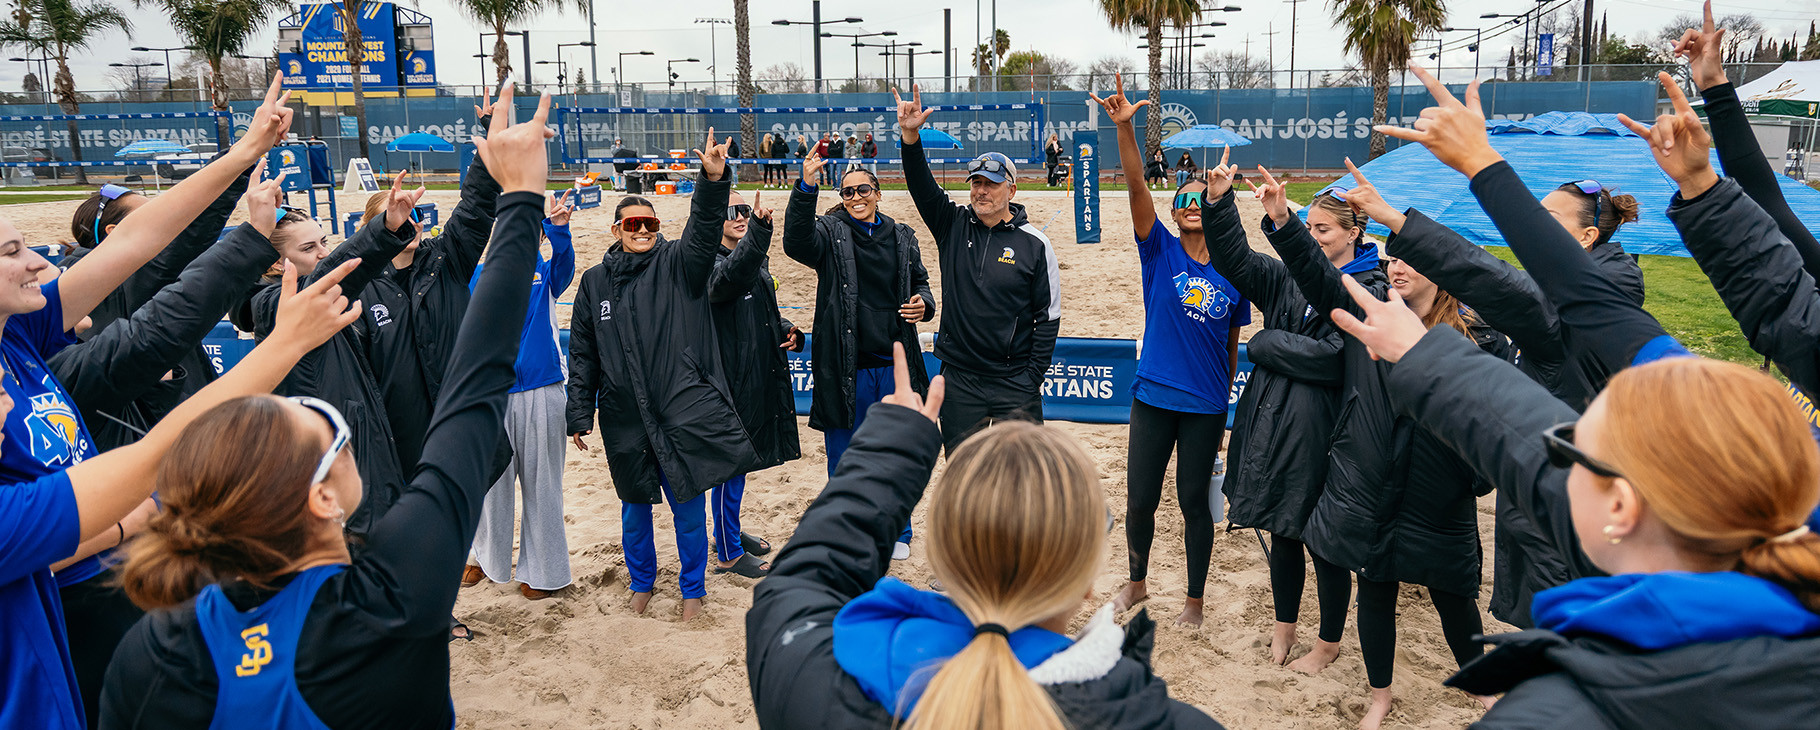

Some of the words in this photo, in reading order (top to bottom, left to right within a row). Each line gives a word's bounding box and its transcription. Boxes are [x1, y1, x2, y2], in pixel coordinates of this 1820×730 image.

[306, 41, 346, 51] MOUNTA
[307, 51, 386, 62] CHAMONS
[342, 65, 371, 74] FOALL
[332, 75, 353, 83] WOME
[548, 122, 616, 142] PARTA
[771, 122, 819, 142] SAN
[892, 121, 961, 142] STE
[1220, 118, 1273, 139] SAN
[1279, 110, 1348, 139] JOSÉ
[368, 125, 409, 144] SAN
[1083, 161, 1092, 231] SPARTANS
[788, 357, 803, 371] SÉ
[1045, 361, 1064, 376] SÉ
[1067, 365, 1114, 378] STATE
[1039, 378, 1114, 400] RTANS
